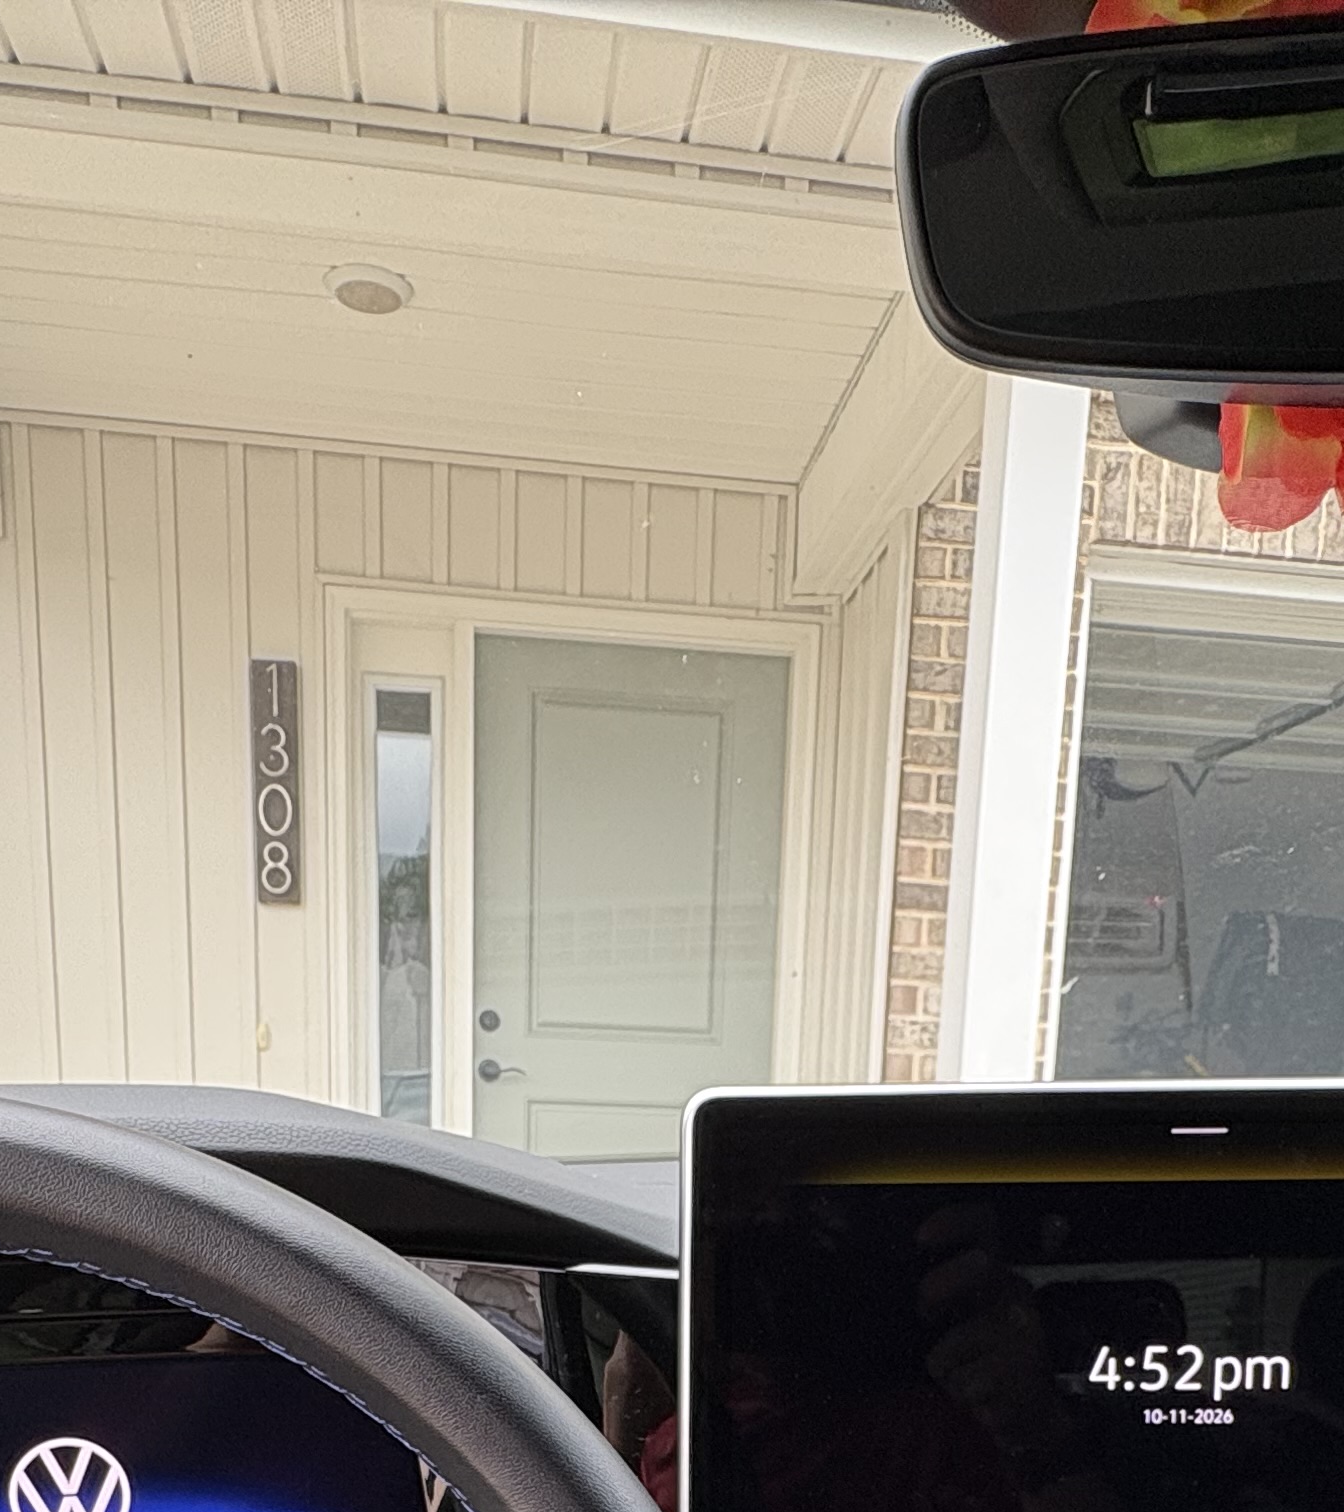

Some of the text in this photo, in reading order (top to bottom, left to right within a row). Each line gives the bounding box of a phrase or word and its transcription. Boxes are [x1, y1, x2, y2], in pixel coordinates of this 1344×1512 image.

[258, 662, 293, 895] 1308
[1088, 1345, 1291, 1402] 4:52 pm
[1142, 1408, 1235, 1425] 10-11-2026
